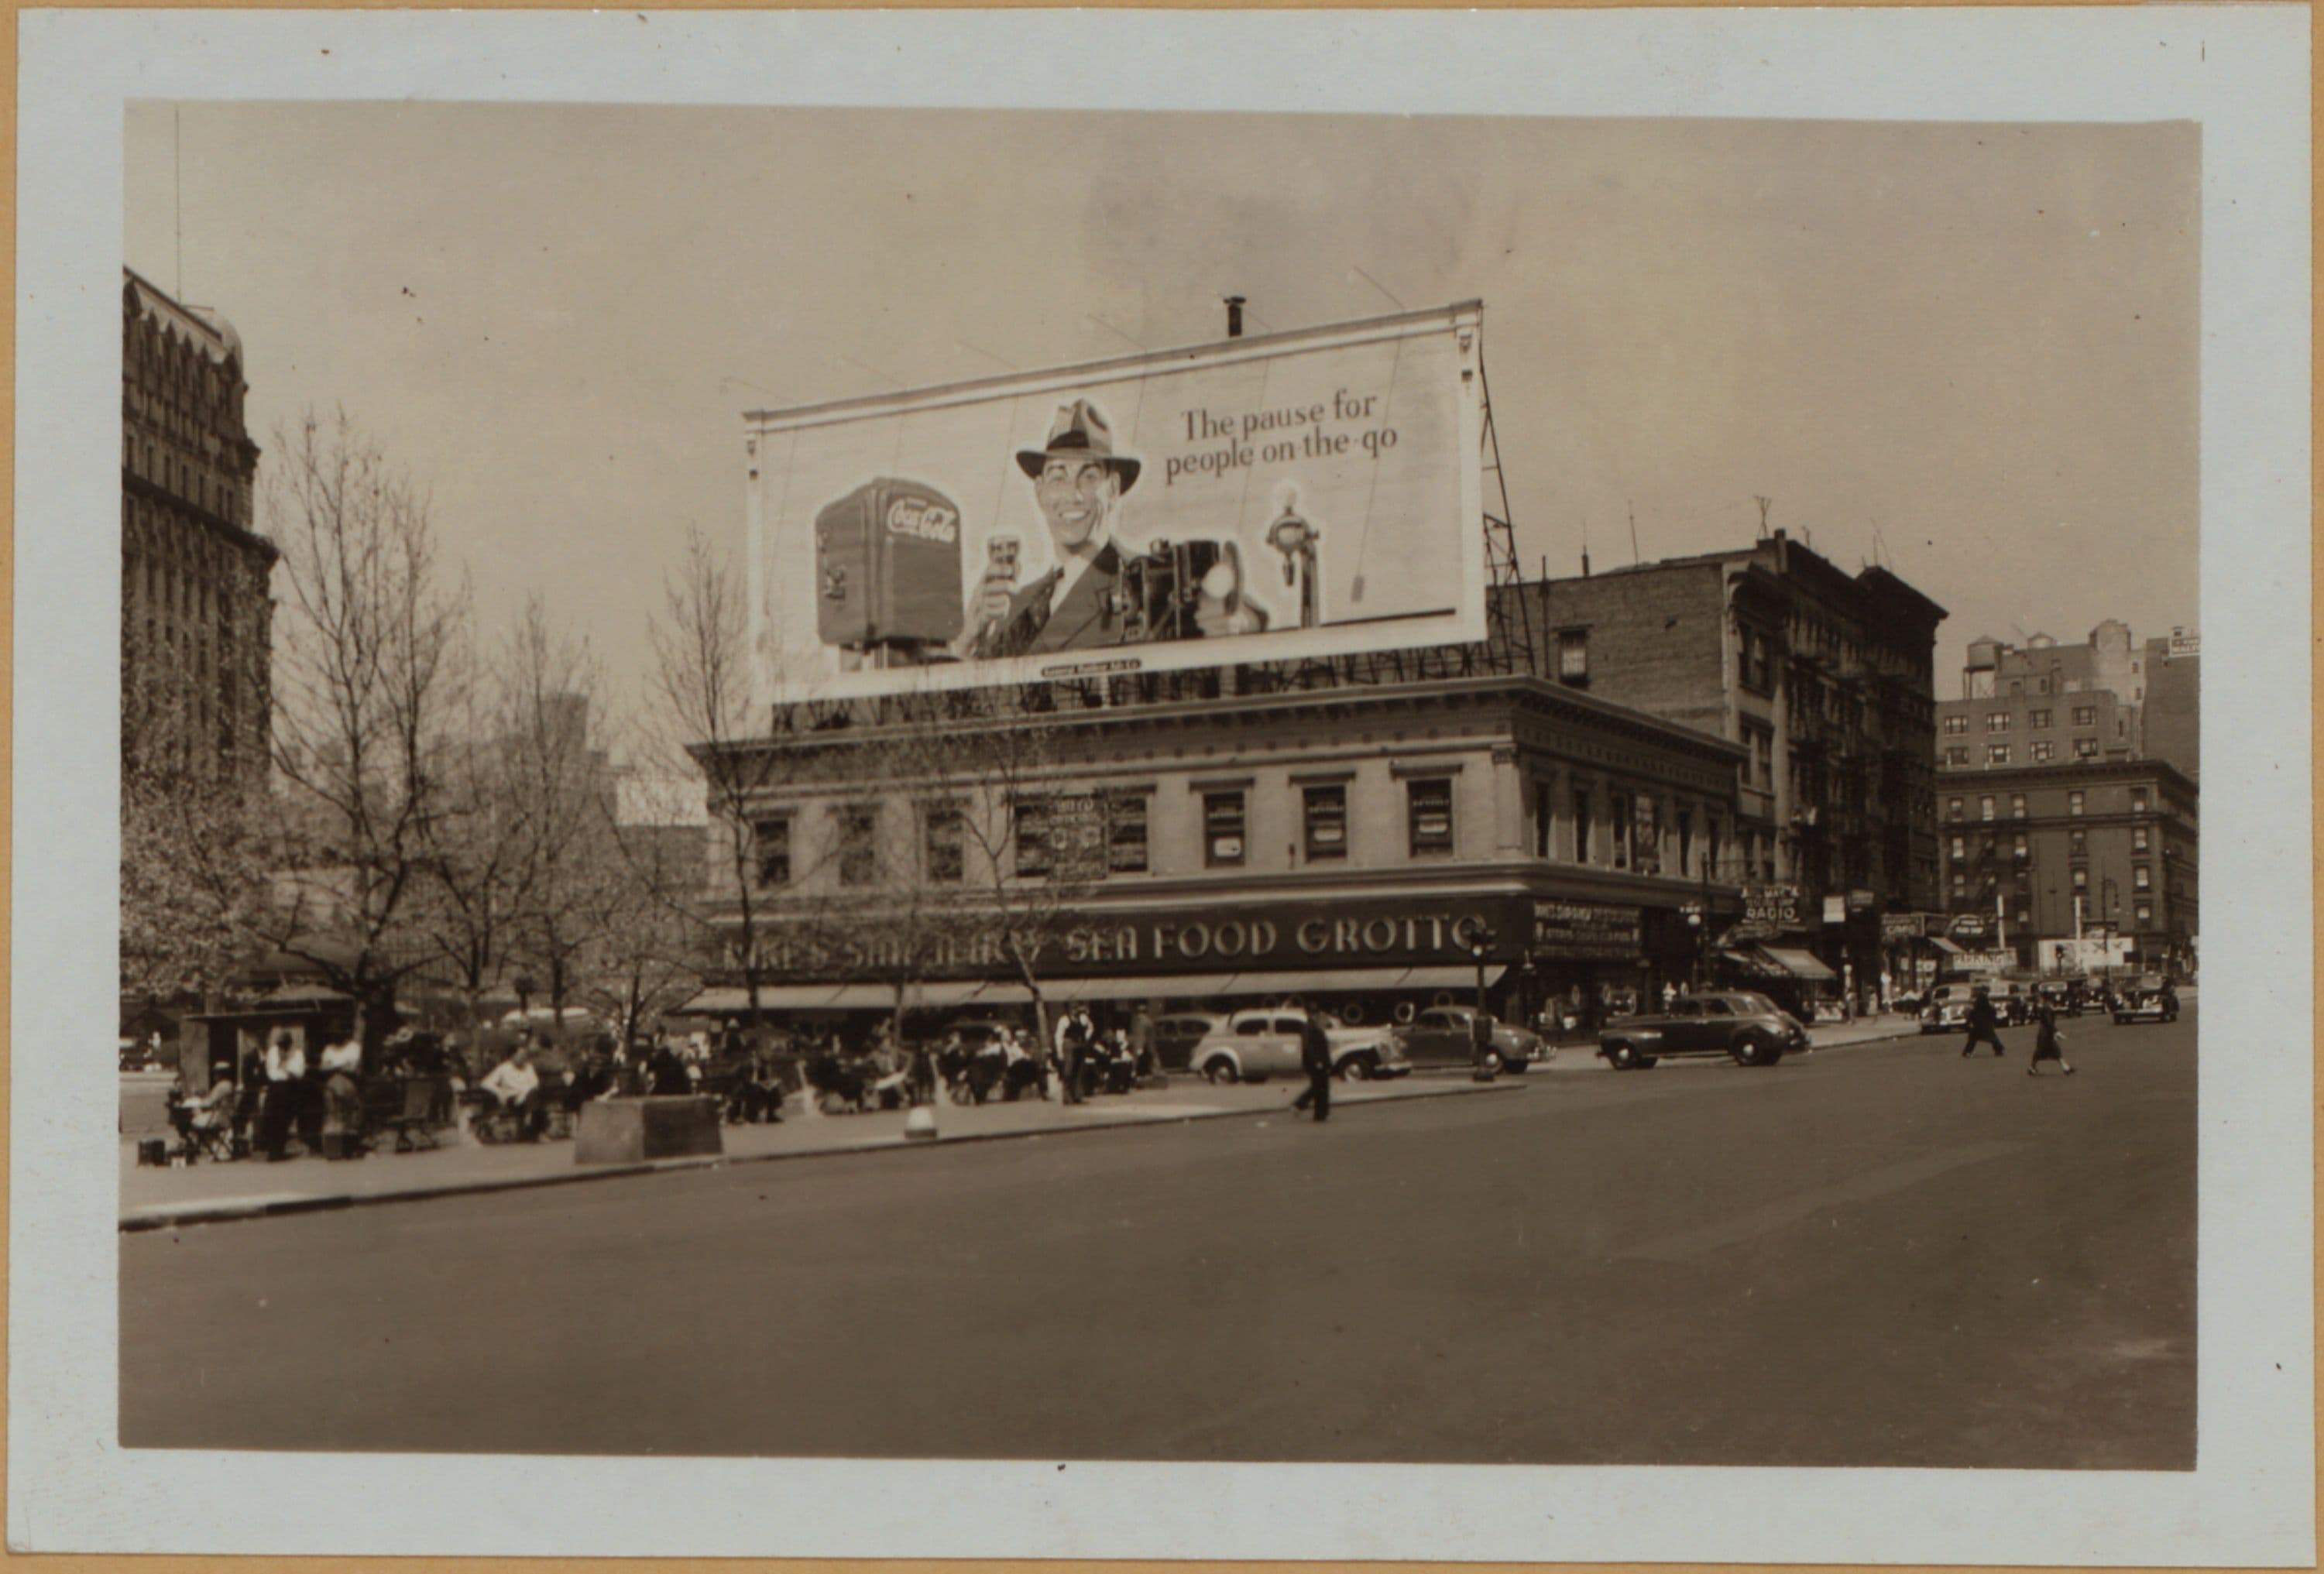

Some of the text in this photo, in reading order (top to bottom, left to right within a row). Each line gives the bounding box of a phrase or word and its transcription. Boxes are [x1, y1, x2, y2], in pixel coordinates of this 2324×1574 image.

[1181, 387, 1378, 441] The pause for
[1165, 437, 1255, 486] people
[1066, 925, 1138, 964] SEA
[1153, 918, 1277, 960] FOOD
[1296, 913, 1487, 955] GROTTO
[1746, 907, 1796, 920] RADIO
